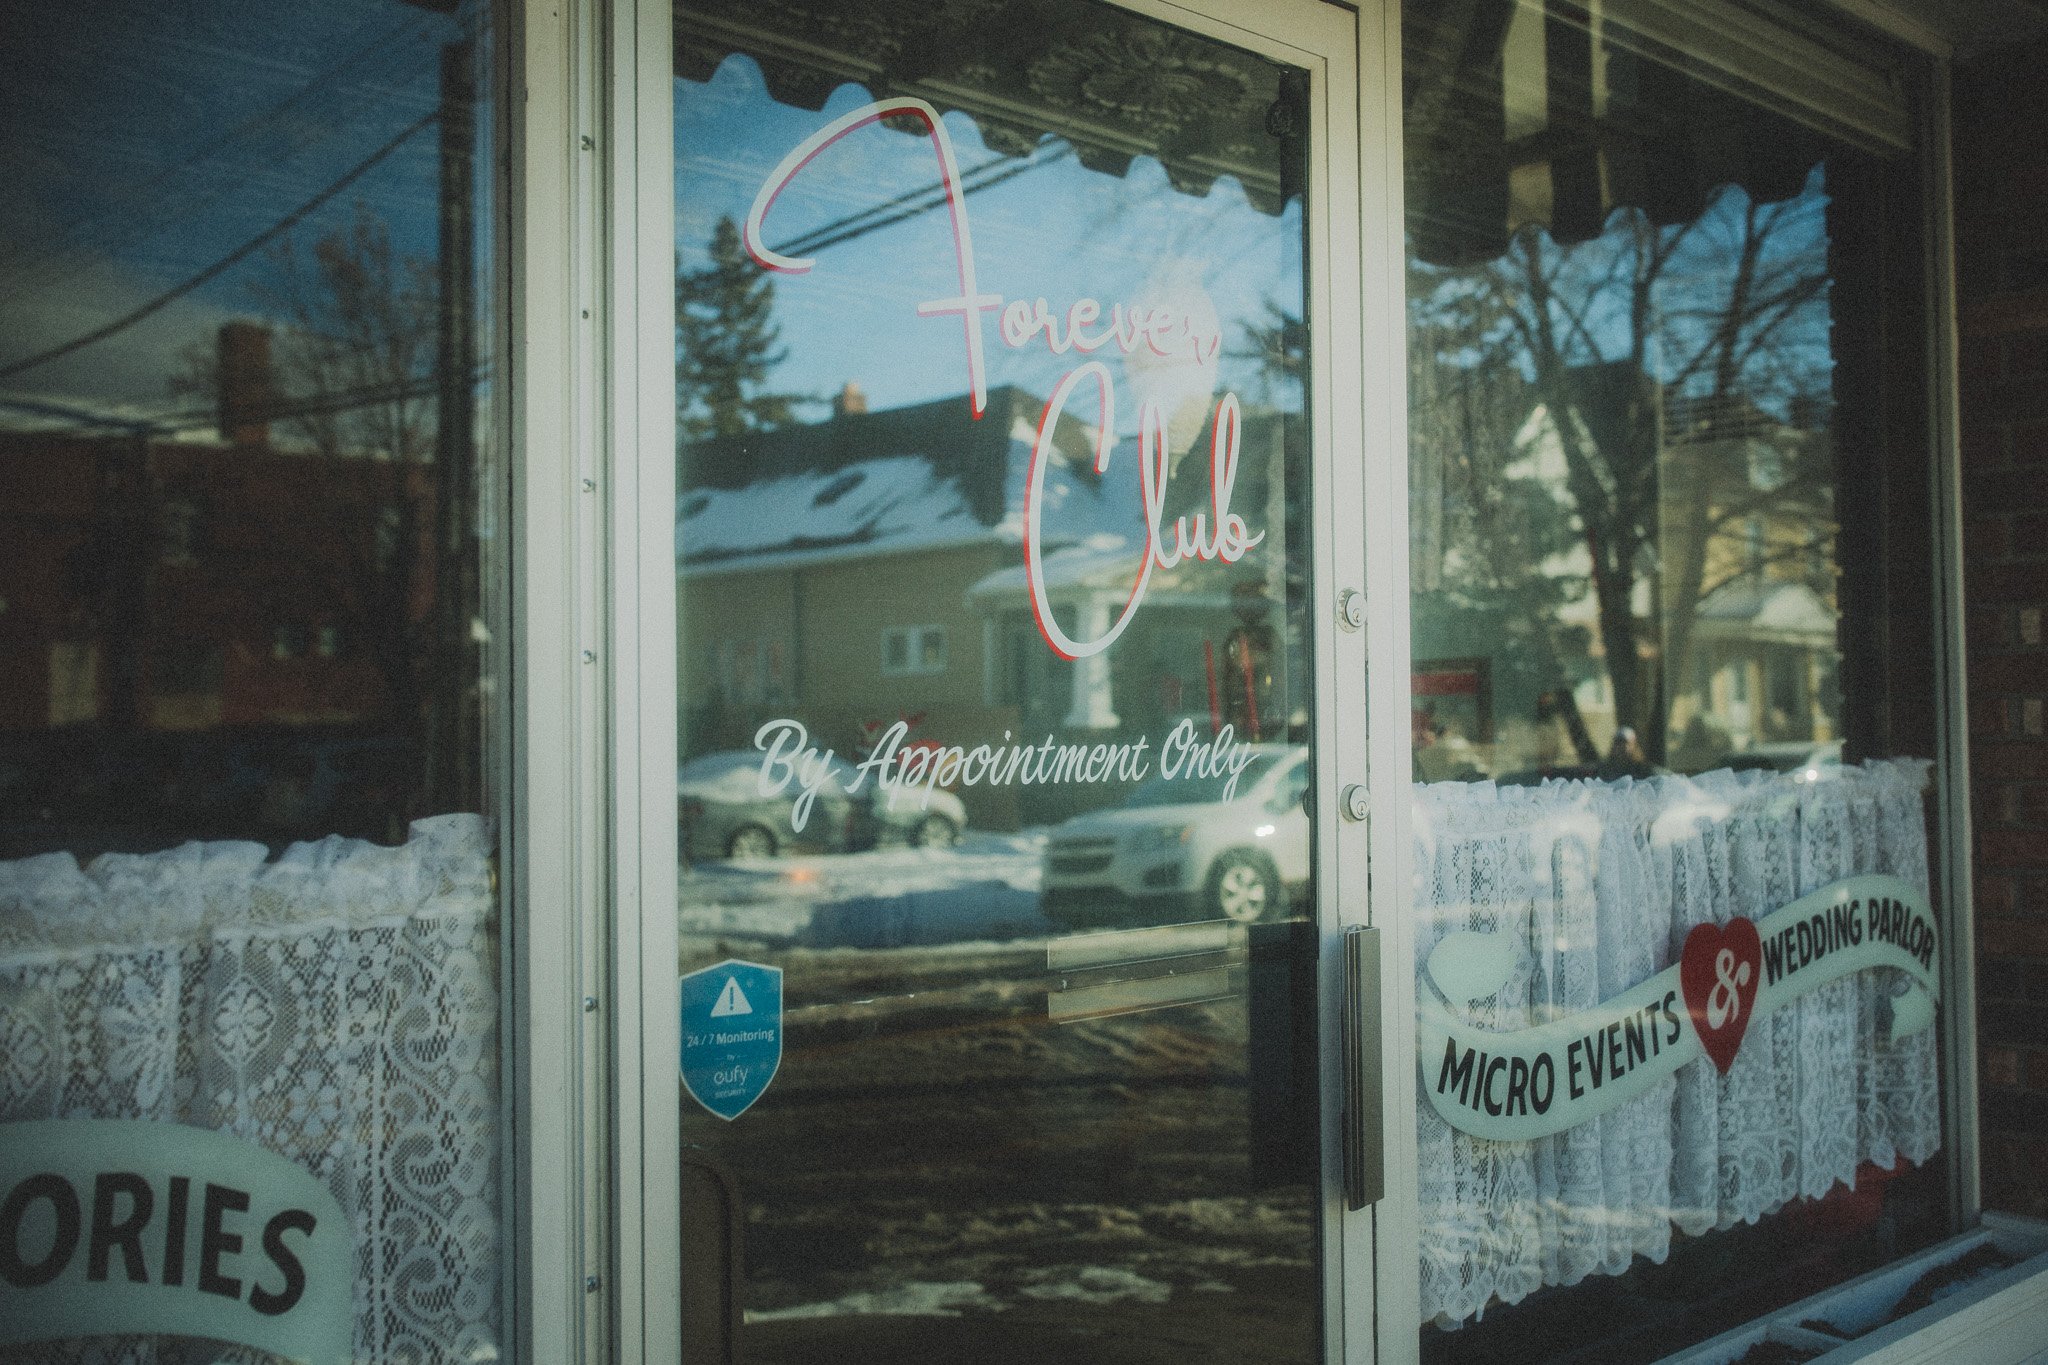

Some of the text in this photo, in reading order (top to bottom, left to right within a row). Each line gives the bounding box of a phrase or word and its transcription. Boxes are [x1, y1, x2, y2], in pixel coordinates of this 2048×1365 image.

[744, 97, 1221, 420] Forever
[1024, 361, 1265, 660] Club
[754, 718, 1261, 833] By Appointment Only
[713, 1064, 749, 1086] eufy
[716, 1028, 775, 1045] Monitoring
[1437, 897, 1936, 1116] MICRO EVENTS & WEDDING PARLOR
